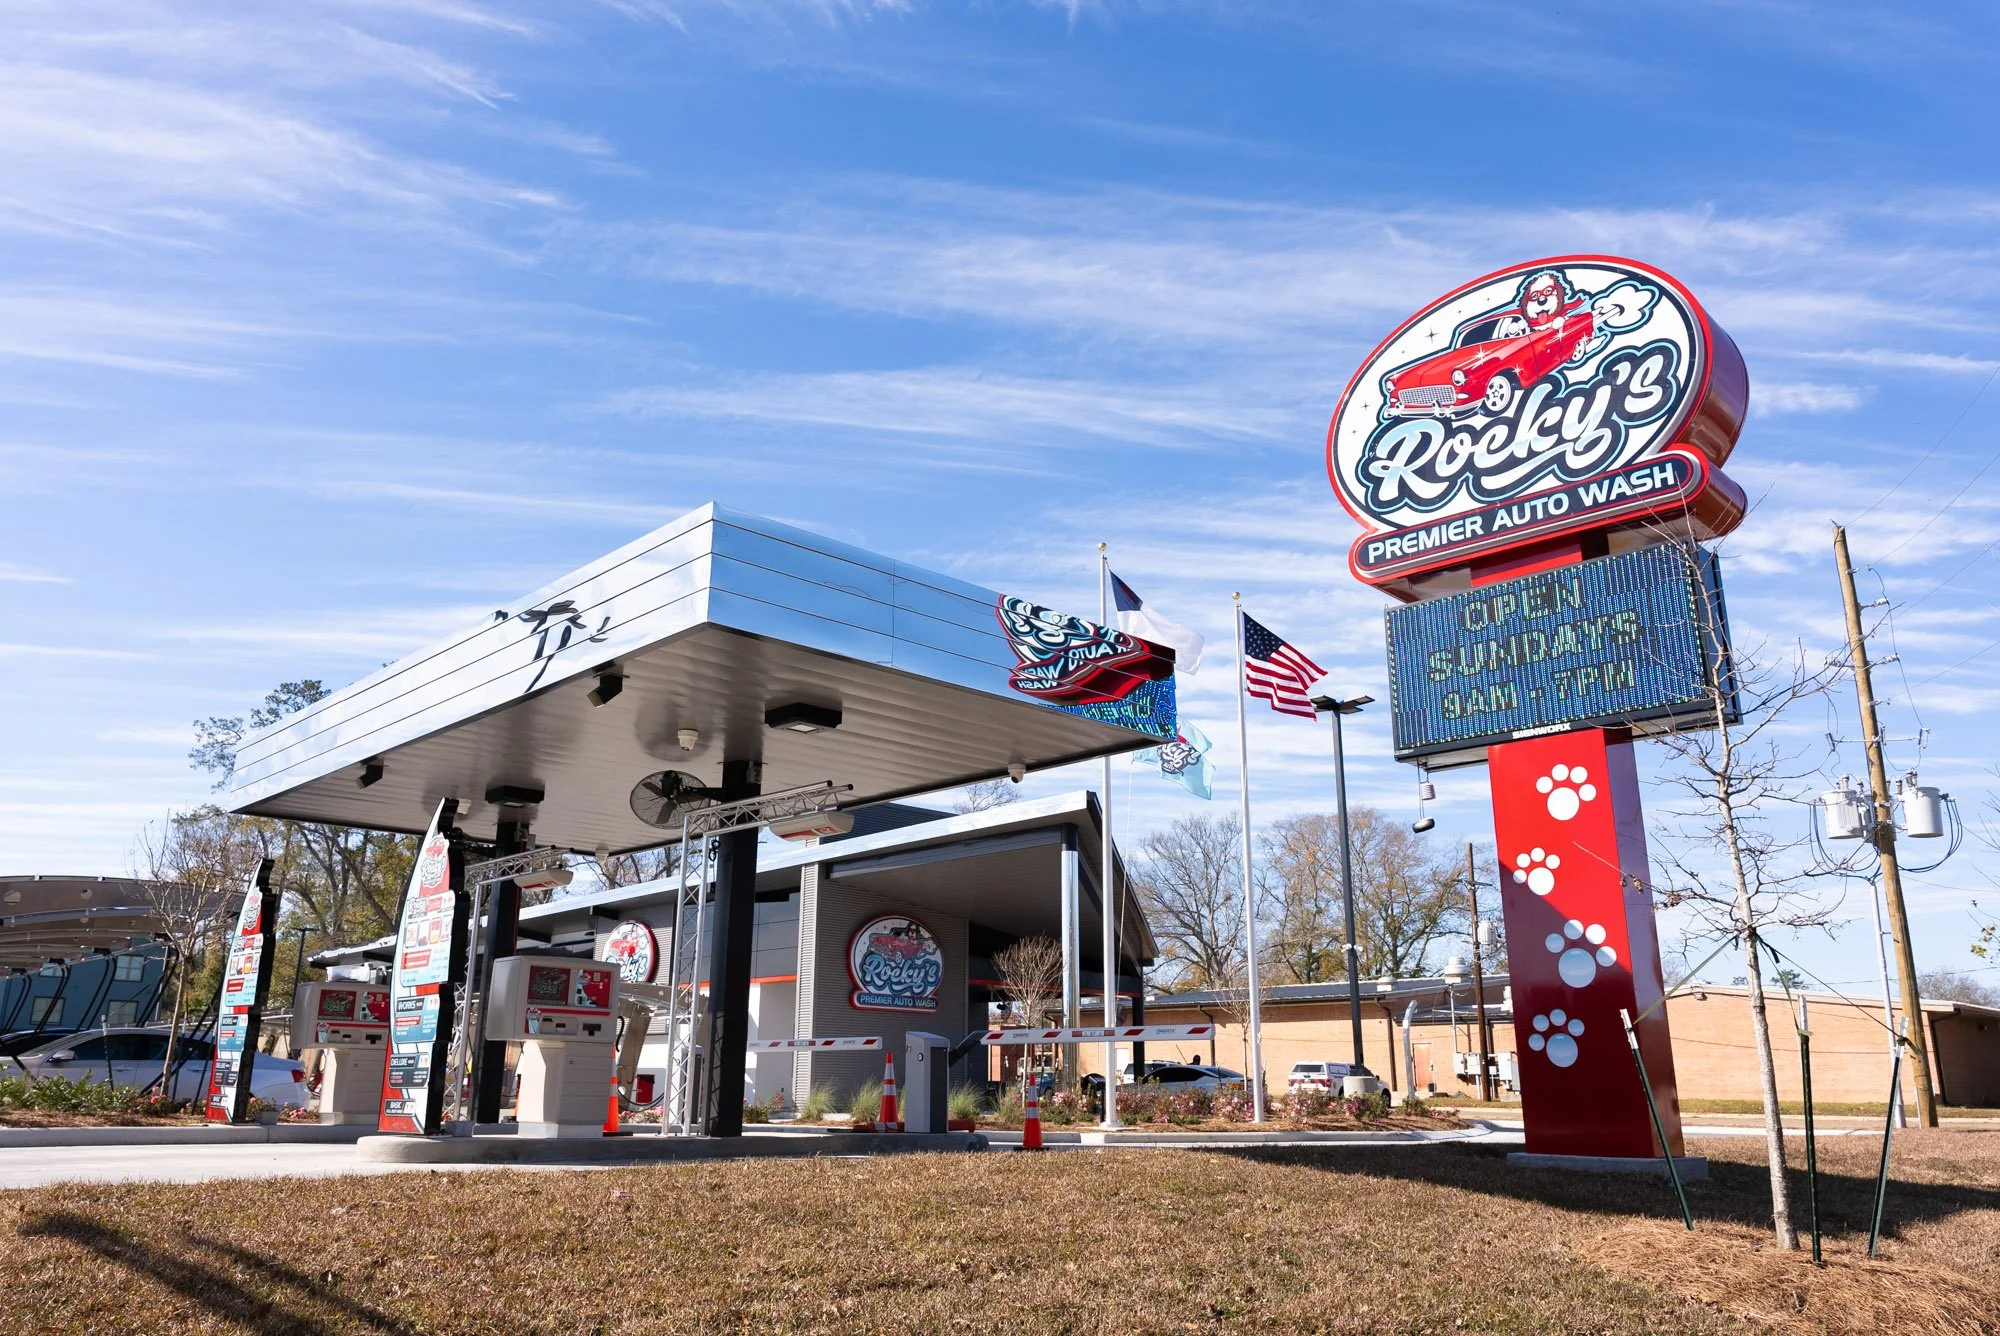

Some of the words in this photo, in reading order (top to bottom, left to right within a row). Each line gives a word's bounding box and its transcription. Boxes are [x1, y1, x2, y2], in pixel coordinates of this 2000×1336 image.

[1369, 355, 1663, 502] Rocky's
[1367, 515, 1484, 564] PREMIER
[1493, 492, 1570, 533] AUTO
[1578, 462, 1676, 508] WASH
[1463, 577, 1585, 632] OPEN
[1428, 608, 1640, 683] SUNDAYS
[860, 995, 892, 1005] PREMIER
[894, 997, 914, 1006] AUTO
[914, 998, 936, 1008] WASH
[862, 955, 937, 993] Rocky's
